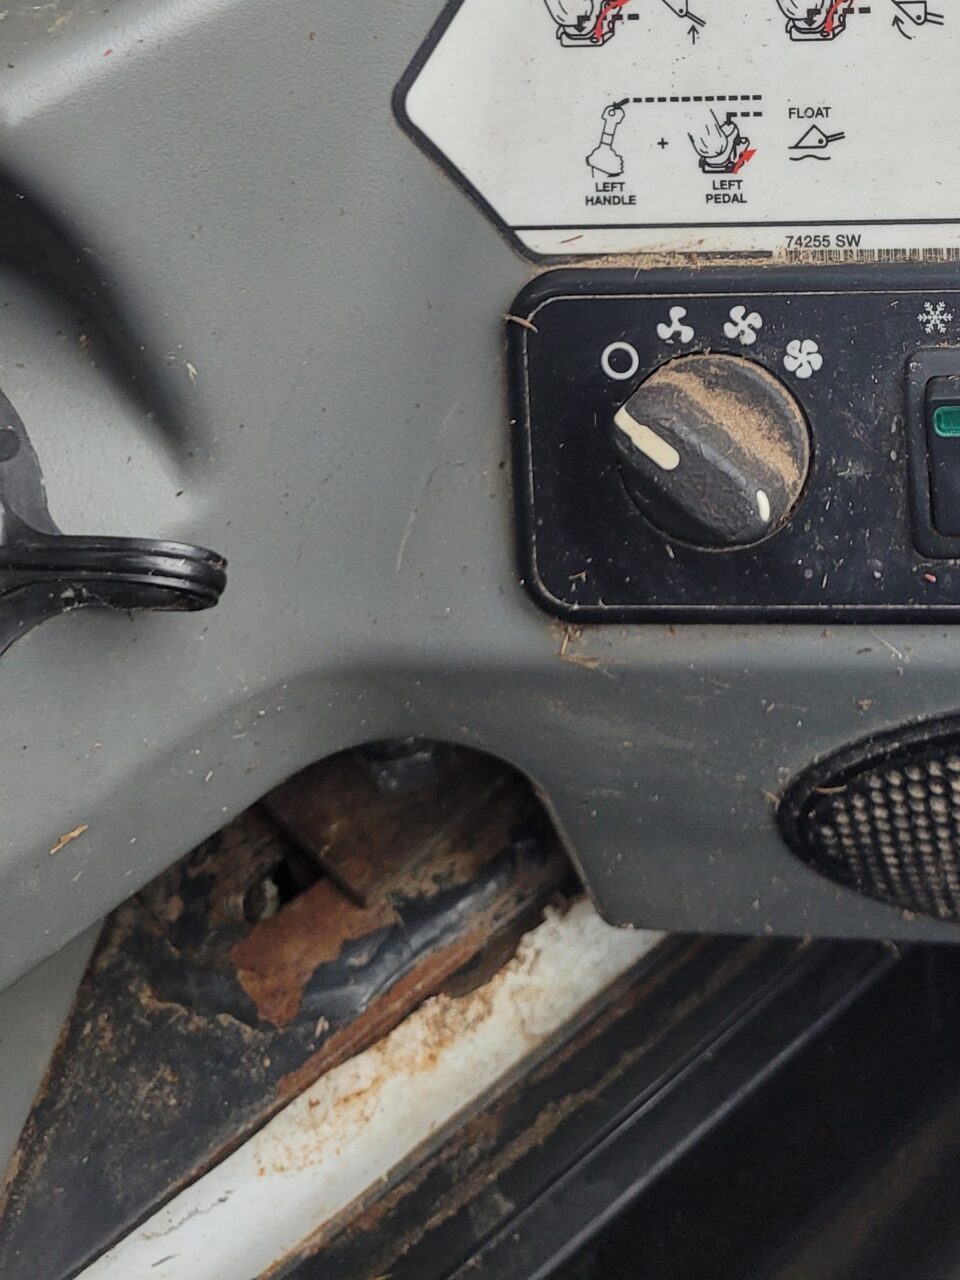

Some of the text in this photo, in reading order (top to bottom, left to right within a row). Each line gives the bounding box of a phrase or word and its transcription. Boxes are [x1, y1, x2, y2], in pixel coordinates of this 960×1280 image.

[789, 107, 831, 119] FLOAT
[595, 182, 625, 192] LEFT
[713, 180, 743, 190] LEFT
[586, 195, 636, 206] HANDLE
[706, 193, 747, 203] PEDAL
[785, 234, 864, 249] 74255 SW
